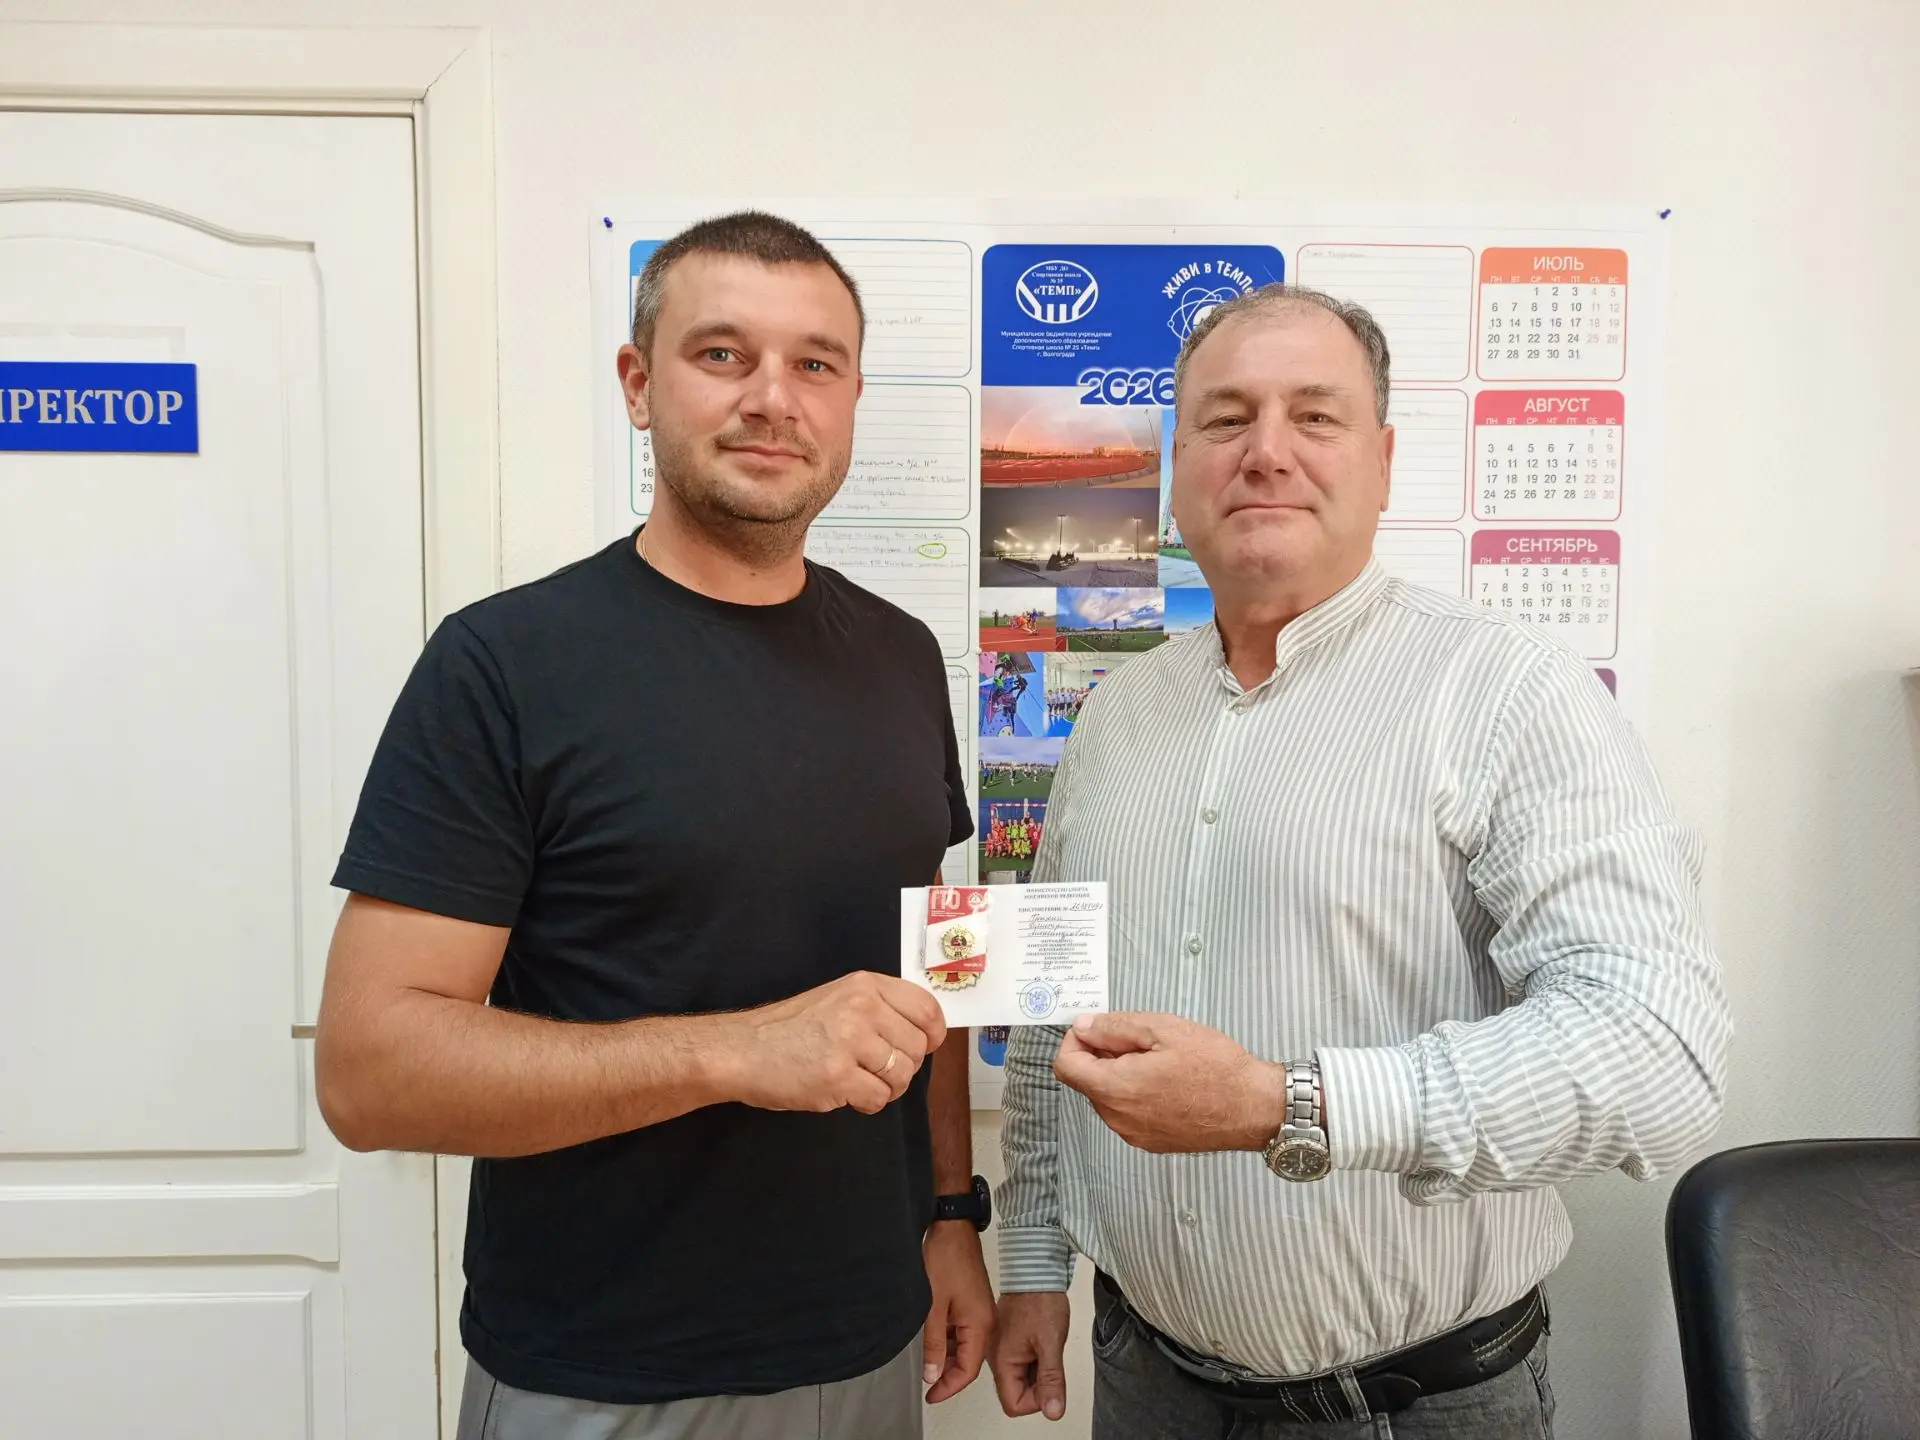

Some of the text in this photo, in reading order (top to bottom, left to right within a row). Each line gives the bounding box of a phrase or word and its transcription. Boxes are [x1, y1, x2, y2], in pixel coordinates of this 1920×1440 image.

[1533, 256, 1584, 271] ИЮЛЬ
[1161, 262, 1200, 299] ЖИВИ
[1034, 285, 1081, 295] «ТЕМП»
[1535, 287, 1616, 296] 1 2 3 4 5
[1492, 303, 1619, 312] 6 7 8 9 10 11 12
[1490, 319, 1619, 327] 13 14 15 16 17 18 19
[1488, 335, 1618, 343] 20 21 22 23 24 25 26
[1488, 350, 1580, 359] 27 28 29 30 31
[1076, 367, 1175, 408] 2026
[0, 389, 183, 425] РЕКТОР
[1524, 398, 1590, 412] АВГУСТ
[1590, 429, 1613, 437] 1 2
[643, 437, 650, 446] 2
[1488, 444, 1494, 453] 3
[1508, 444, 1513, 453] 4
[1528, 444, 1534, 453] 5
[1548, 444, 1554, 453] 6
[1568, 444, 1574, 453] 7
[1607, 444, 1613, 453] 9
[643, 453, 650, 461] 9
[1487, 460, 1616, 468] 10 11 12 13 14 15 16
[643, 468, 654, 477] 16
[1487, 475, 1498, 484] 17
[1506, 475, 1517, 484] 18
[1527, 475, 1538, 484] 19
[1544, 475, 1556, 484] 20
[1565, 475, 1576, 484] 21
[1585, 475, 1596, 484] 22
[641, 484, 653, 493] 23
[1484, 490, 1614, 499] 24 25 26 27 28 29 30
[1485, 505, 1496, 514] 31
[1507, 538, 1598, 552] СЕНТЯБРЬ
[1505, 568, 1607, 577] 1 2 3 4 5 6
[1483, 583, 1610, 592] 7 8 9 10 11 12 13
[1481, 599, 1609, 607] 14 15 16 17 18 19 20
[1539, 614, 1550, 623] 24
[1558, 614, 1570, 623] 25
[1578, 614, 1589, 623] 26
[1597, 614, 1608, 623] 27
[931, 889, 960, 910] ГТО
